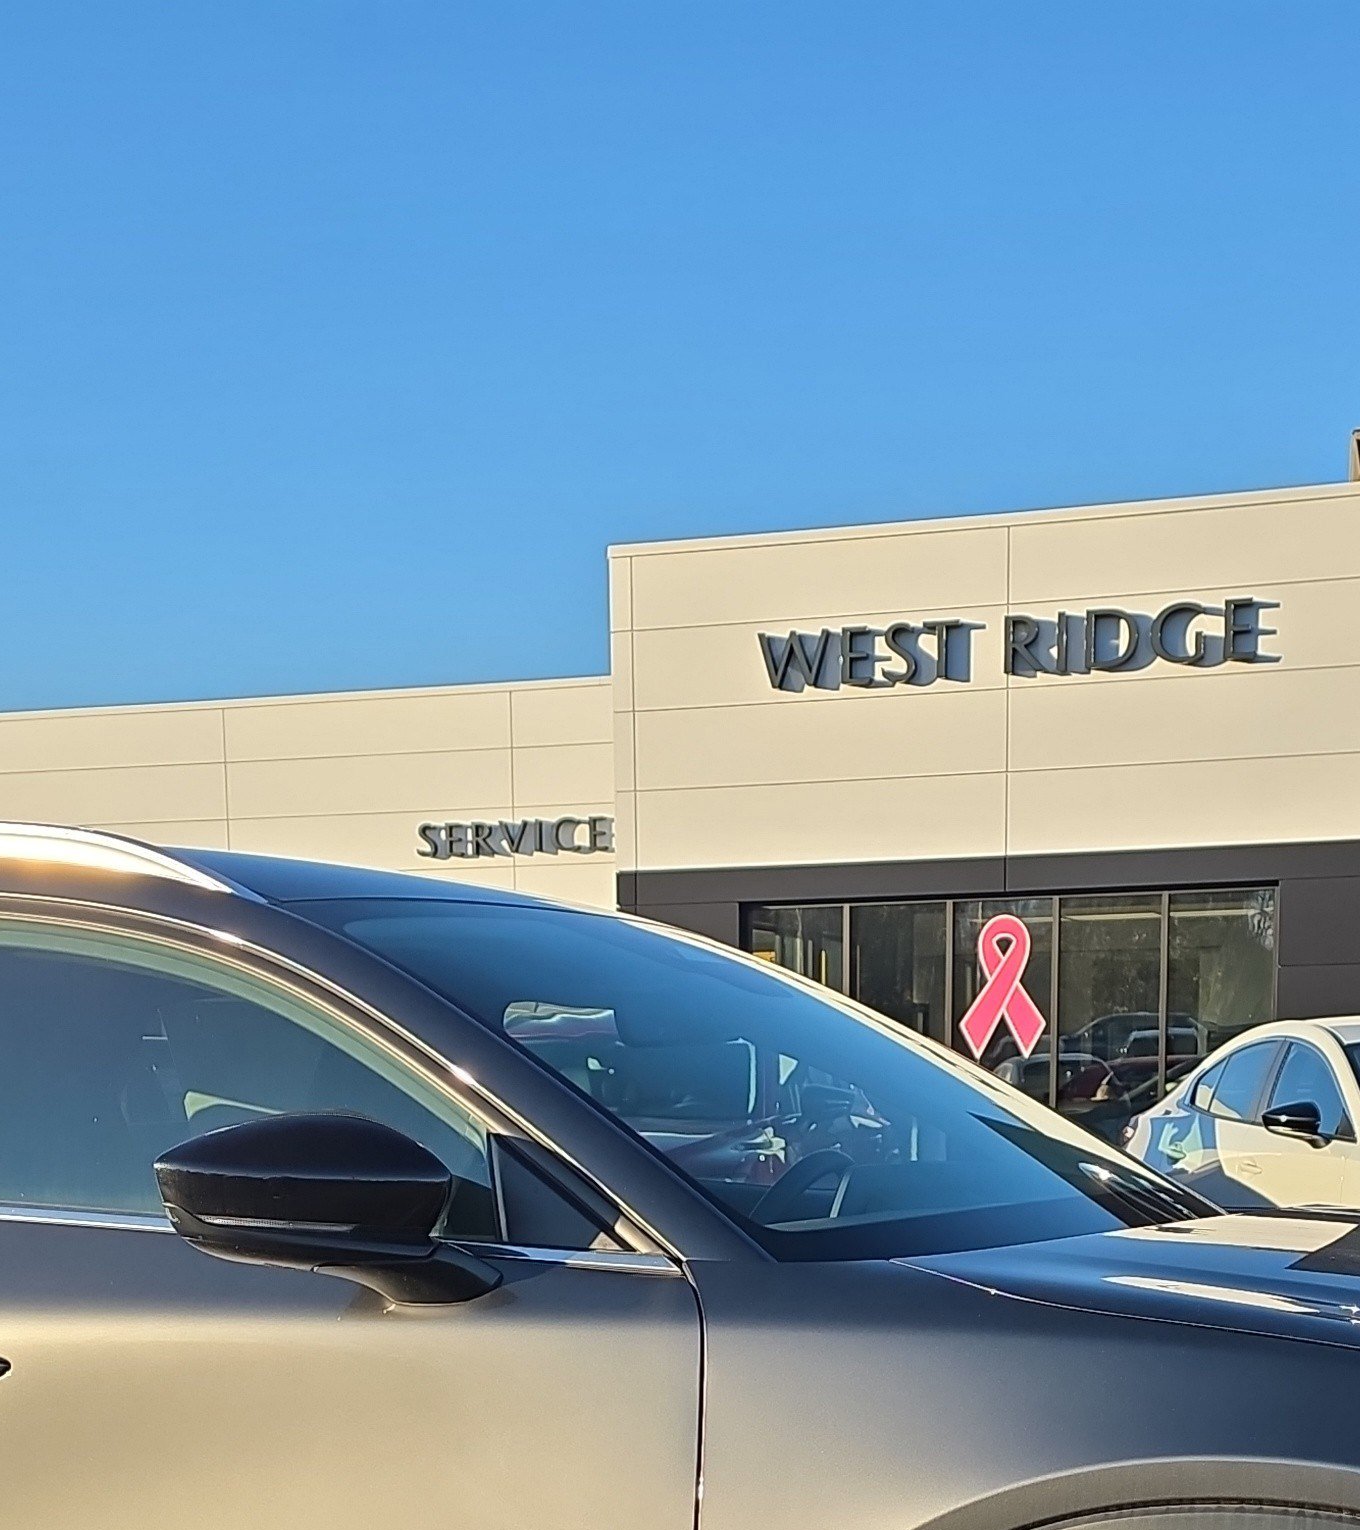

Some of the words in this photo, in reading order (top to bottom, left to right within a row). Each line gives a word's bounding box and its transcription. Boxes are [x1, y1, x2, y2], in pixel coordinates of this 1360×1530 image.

[757, 617, 970, 692] WEST
[1004, 596, 1260, 676] RIDGE
[416, 816, 611, 859] SERVICE
